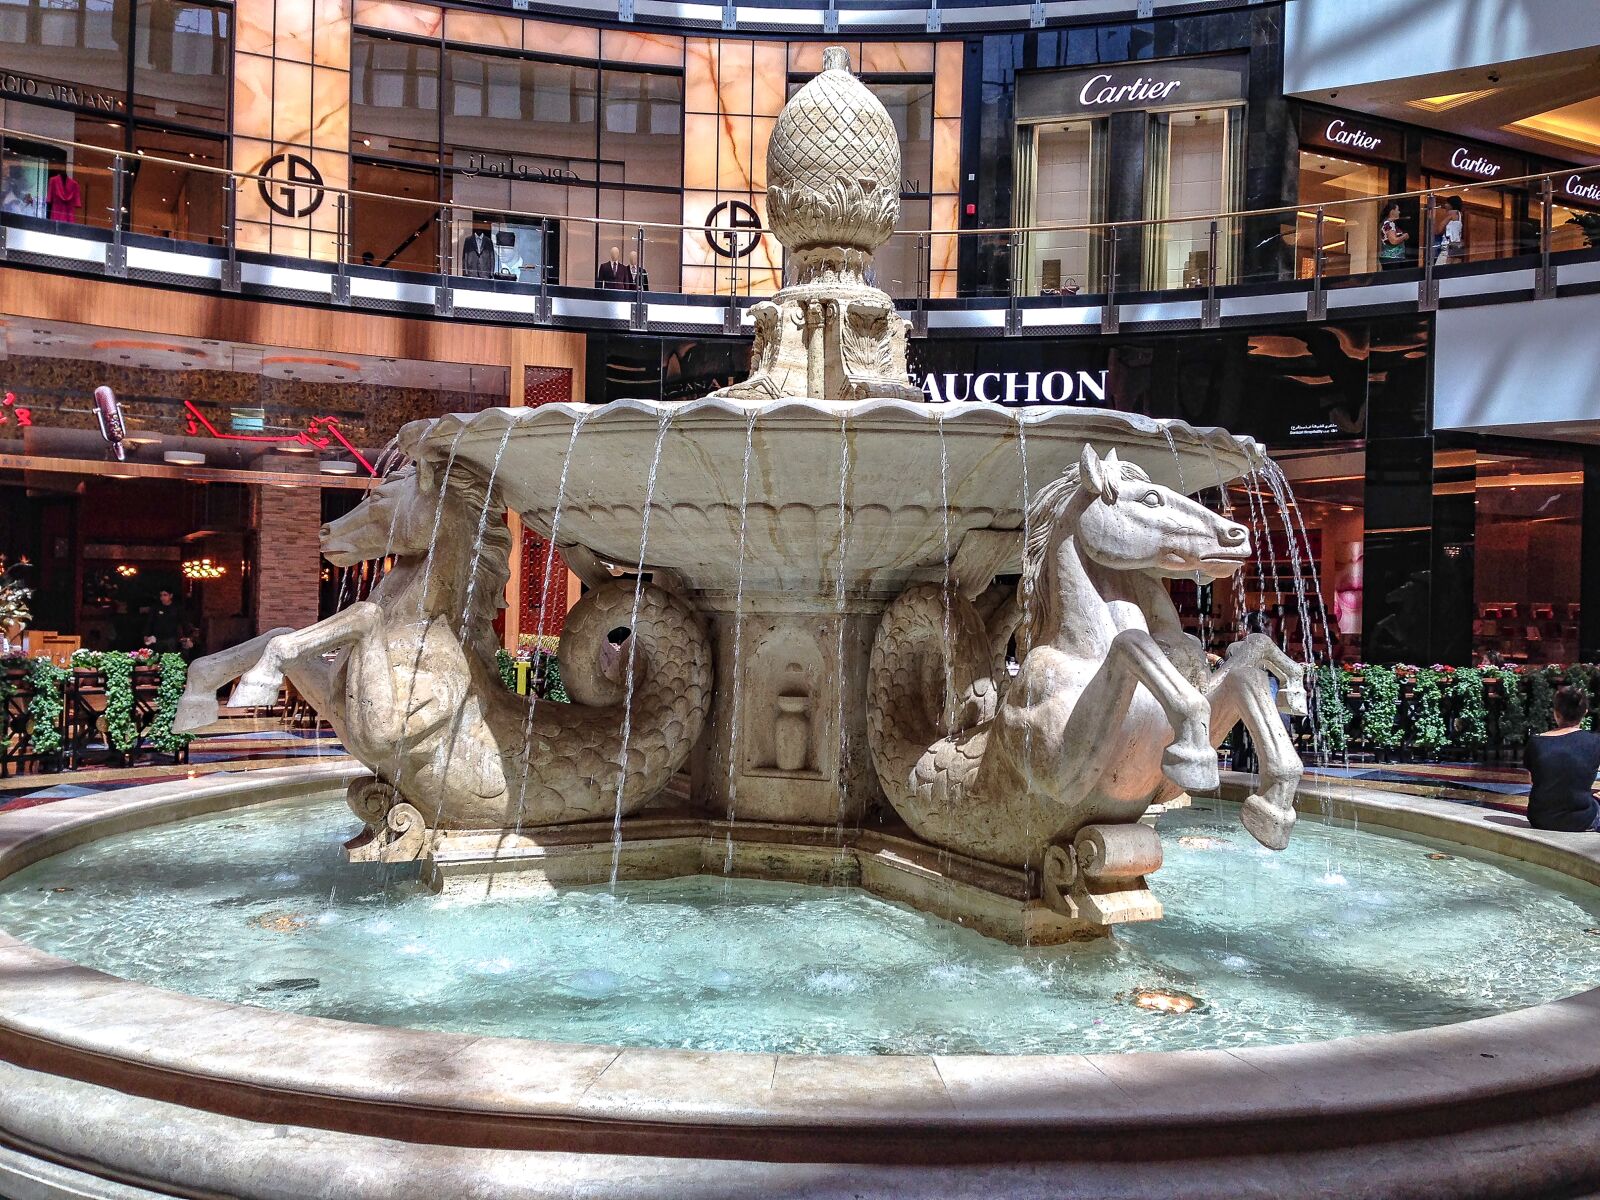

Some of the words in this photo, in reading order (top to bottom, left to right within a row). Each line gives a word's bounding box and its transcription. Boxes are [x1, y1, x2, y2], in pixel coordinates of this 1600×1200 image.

[0, 74, 38, 97] GIO
[47, 84, 117, 112] ARMANI
[1080, 75, 1181, 105] Cartier
[1326, 120, 1381, 149] Cartier
[1451, 148, 1501, 176] Cartier
[1566, 174, 1600, 200] Cartie
